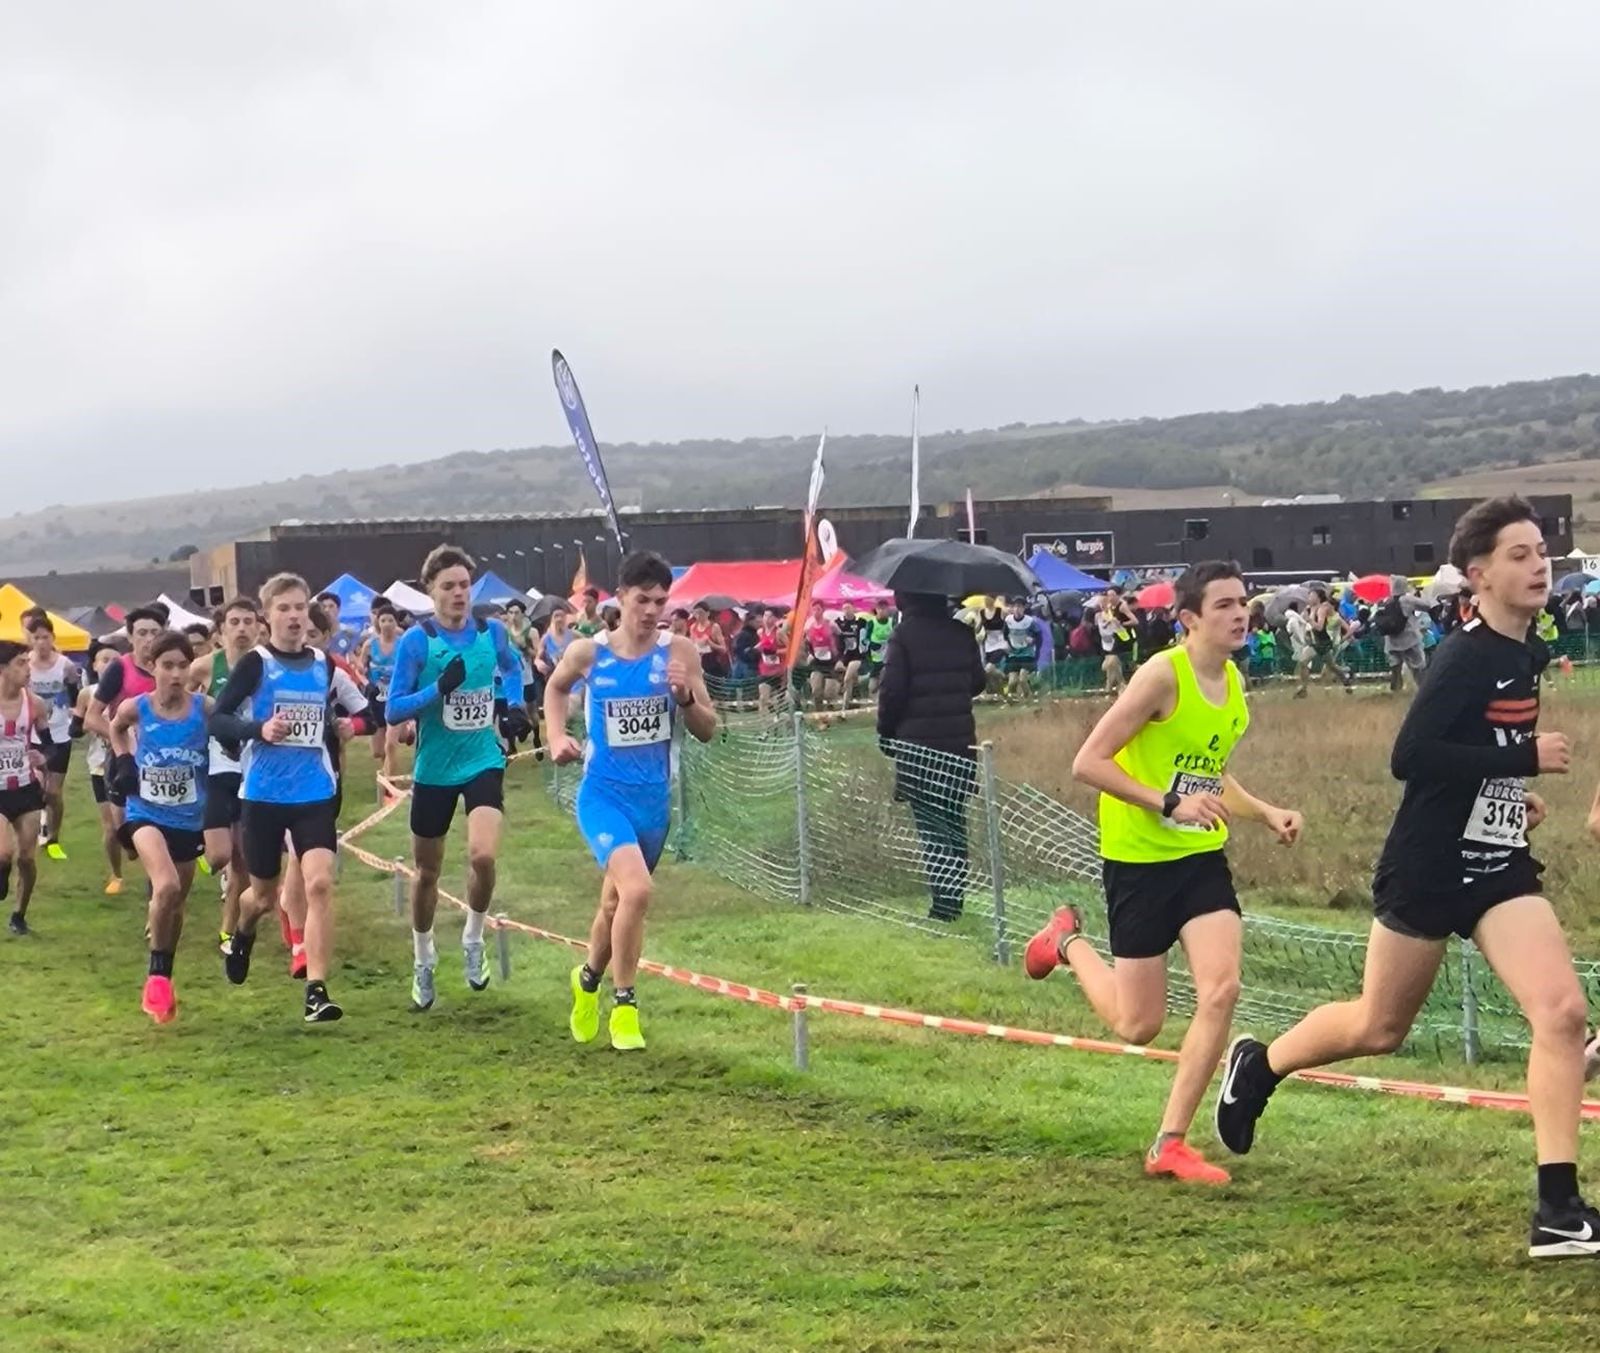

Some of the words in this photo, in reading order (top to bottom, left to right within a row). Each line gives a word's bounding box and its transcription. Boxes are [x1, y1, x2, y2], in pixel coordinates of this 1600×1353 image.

[453, 704, 488, 720] 3123
[618, 716, 661, 734] 3044
[151, 782, 188, 797] 3186
[1483, 801, 1524, 830] 3145
